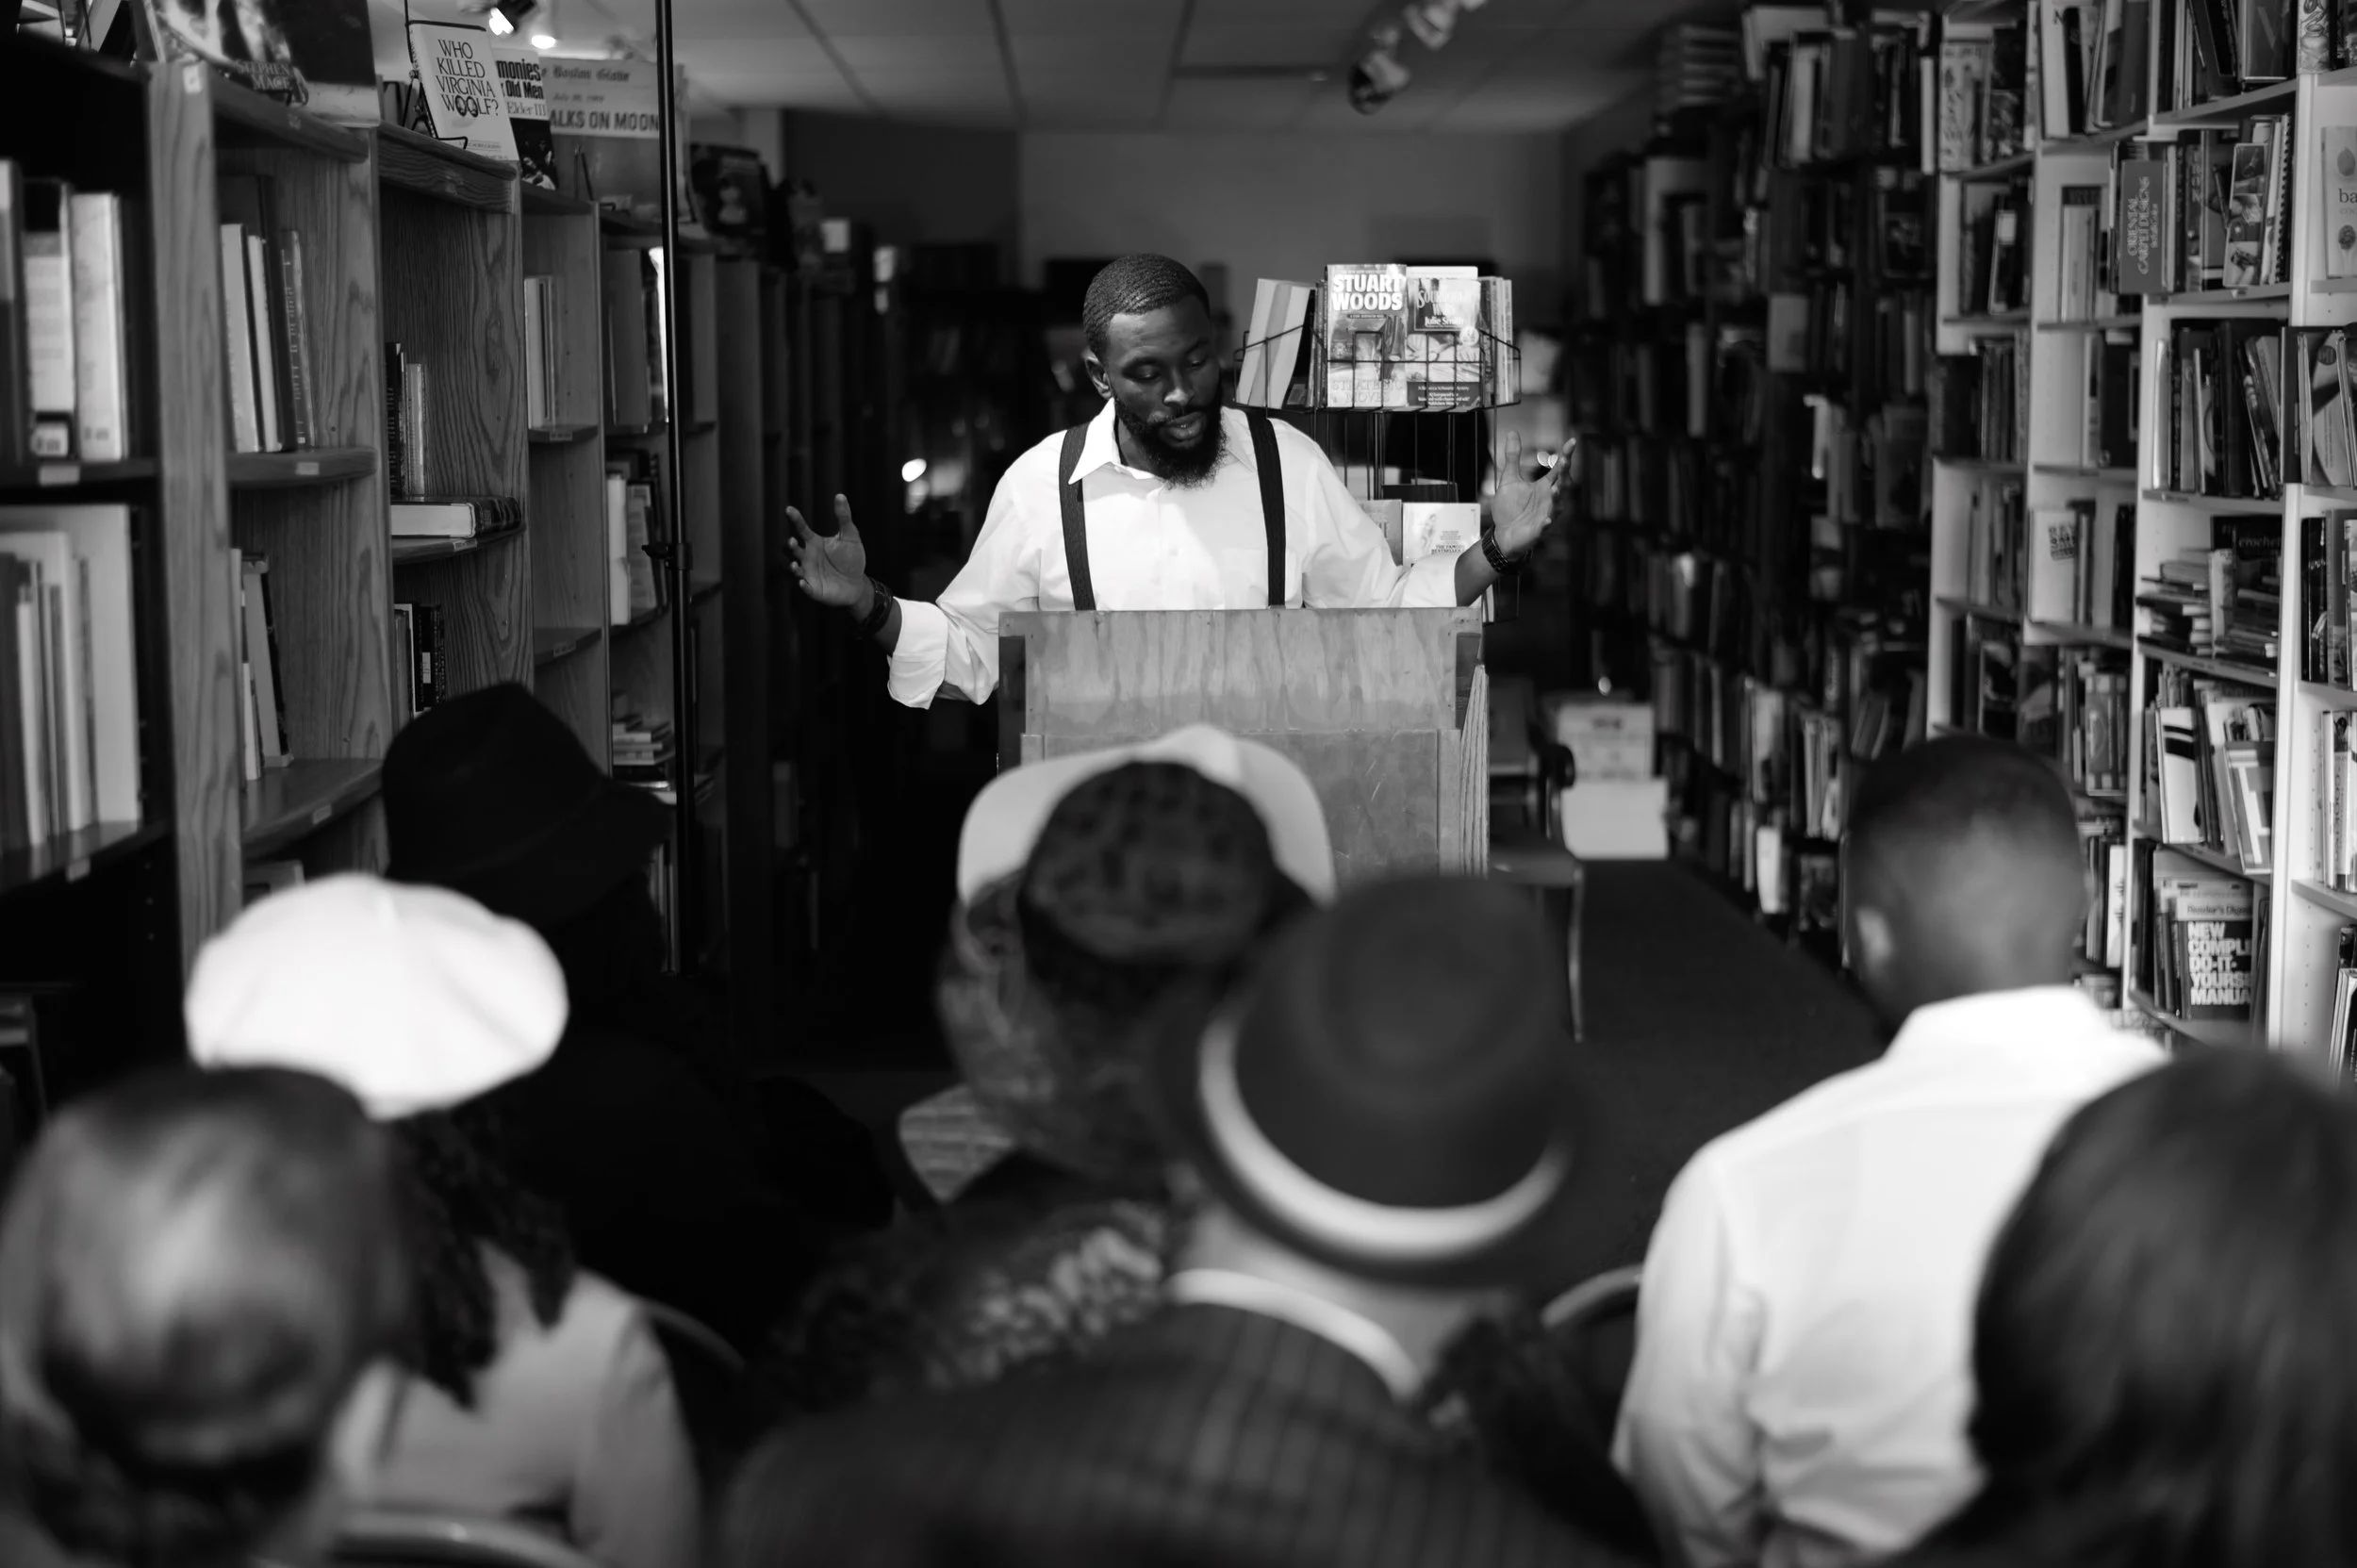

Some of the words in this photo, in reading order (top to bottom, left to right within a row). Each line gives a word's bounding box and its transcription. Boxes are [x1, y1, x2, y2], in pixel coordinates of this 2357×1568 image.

[437, 39, 473, 59] WHO
[437, 57, 486, 78] KILLED
[436, 75, 496, 98] VIRGINIA
[505, 80, 521, 98] Old
[522, 81, 544, 100] Men
[441, 93, 499, 118] WOOLF?
[549, 108, 585, 129] ALKS
[588, 110, 610, 130] ON
[614, 112, 660, 132] MOON
[1333, 273, 1402, 292] STUART
[1331, 292, 1403, 311] WOODS
[2187, 921, 2226, 939] NEW
